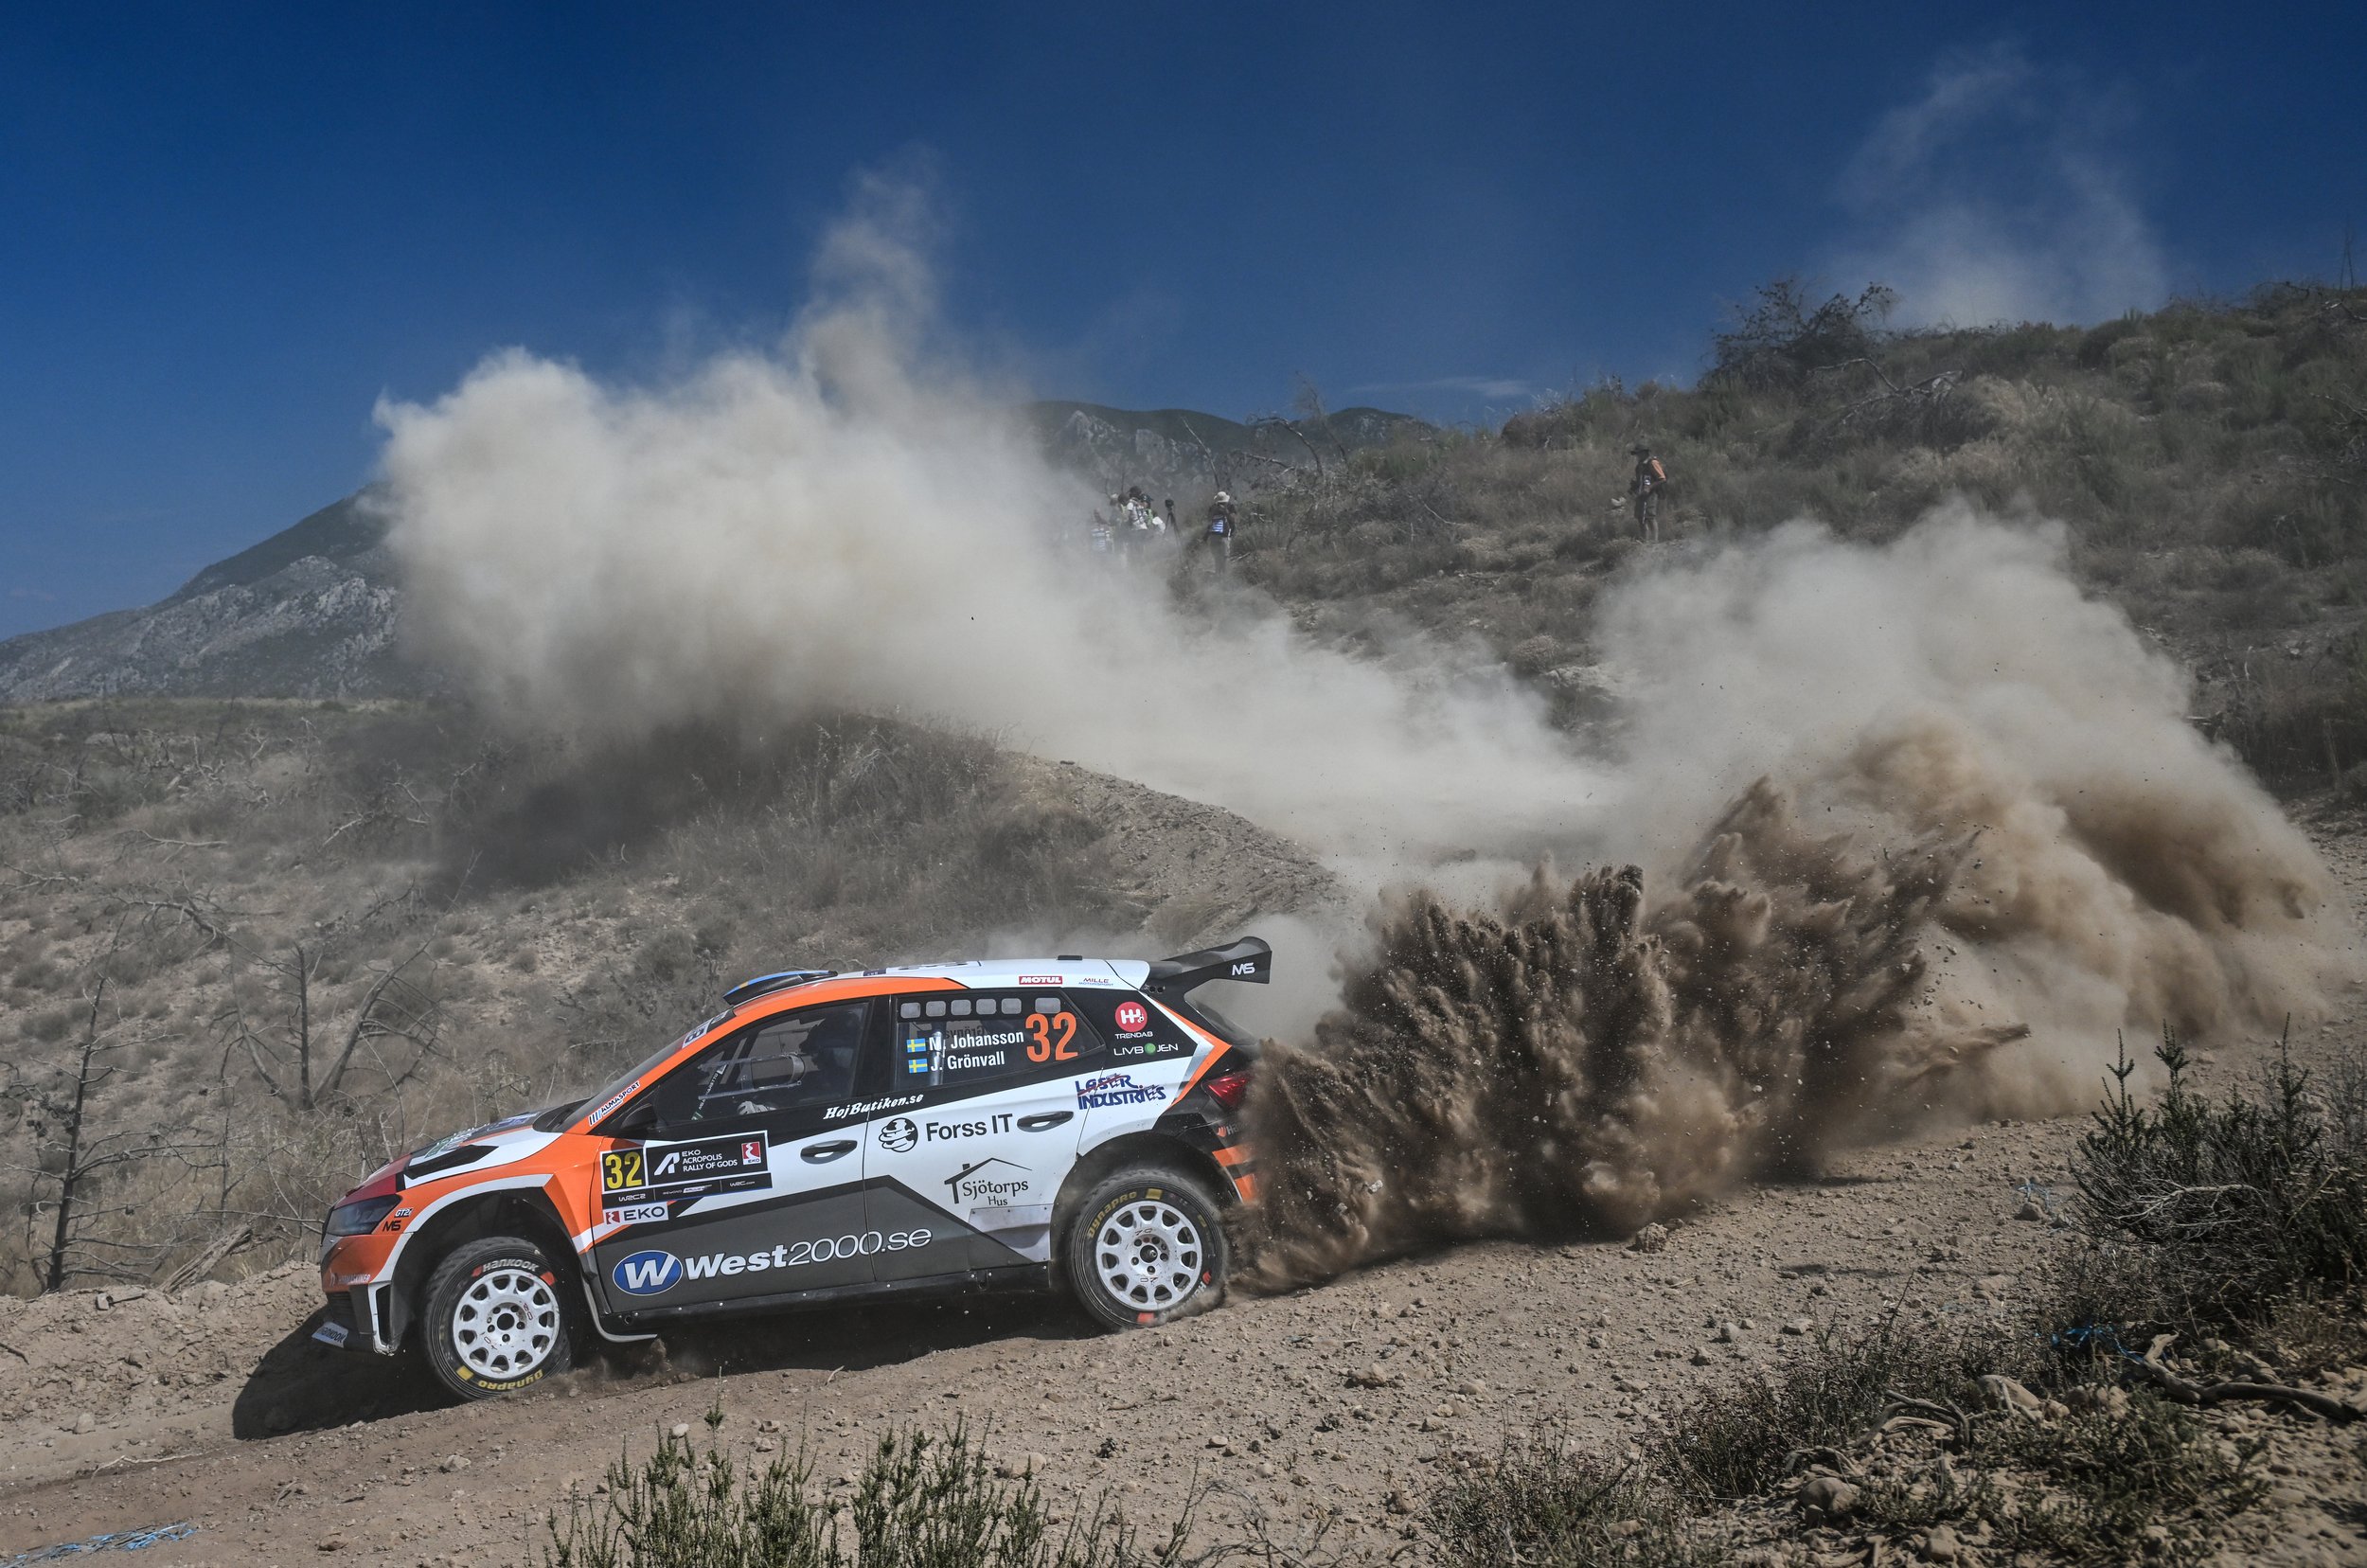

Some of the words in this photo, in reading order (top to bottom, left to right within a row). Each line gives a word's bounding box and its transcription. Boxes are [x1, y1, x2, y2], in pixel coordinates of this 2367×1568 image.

[1020, 976, 1062, 985] MOTUL
[950, 1030, 1024, 1050] Johansson
[1024, 1011, 1079, 1063] 32
[1114, 1031, 1153, 1040] TRENDAB
[930, 1058, 943, 1072] J.
[947, 1050, 1006, 1071] Grönvall
[601, 1081, 641, 1114] ALMASPORT
[823, 1092, 924, 1120] HojButiken.se
[925, 1119, 988, 1142] Forss
[991, 1113, 1013, 1134] IT
[681, 1149, 702, 1157] EKO
[682, 1153, 722, 1165] ACROPOLIS
[604, 1151, 643, 1190] 32
[683, 1163, 703, 1172] RALLY
[705, 1161, 717, 1169] OF
[717, 1159, 739, 1167] GODS
[618, 1192, 647, 1203] WRC2
[962, 1179, 1029, 1201] Sjötorps
[988, 1195, 1008, 1206] Hus
[623, 1206, 666, 1221] EKO
[685, 1227, 933, 1281] West2000.se
